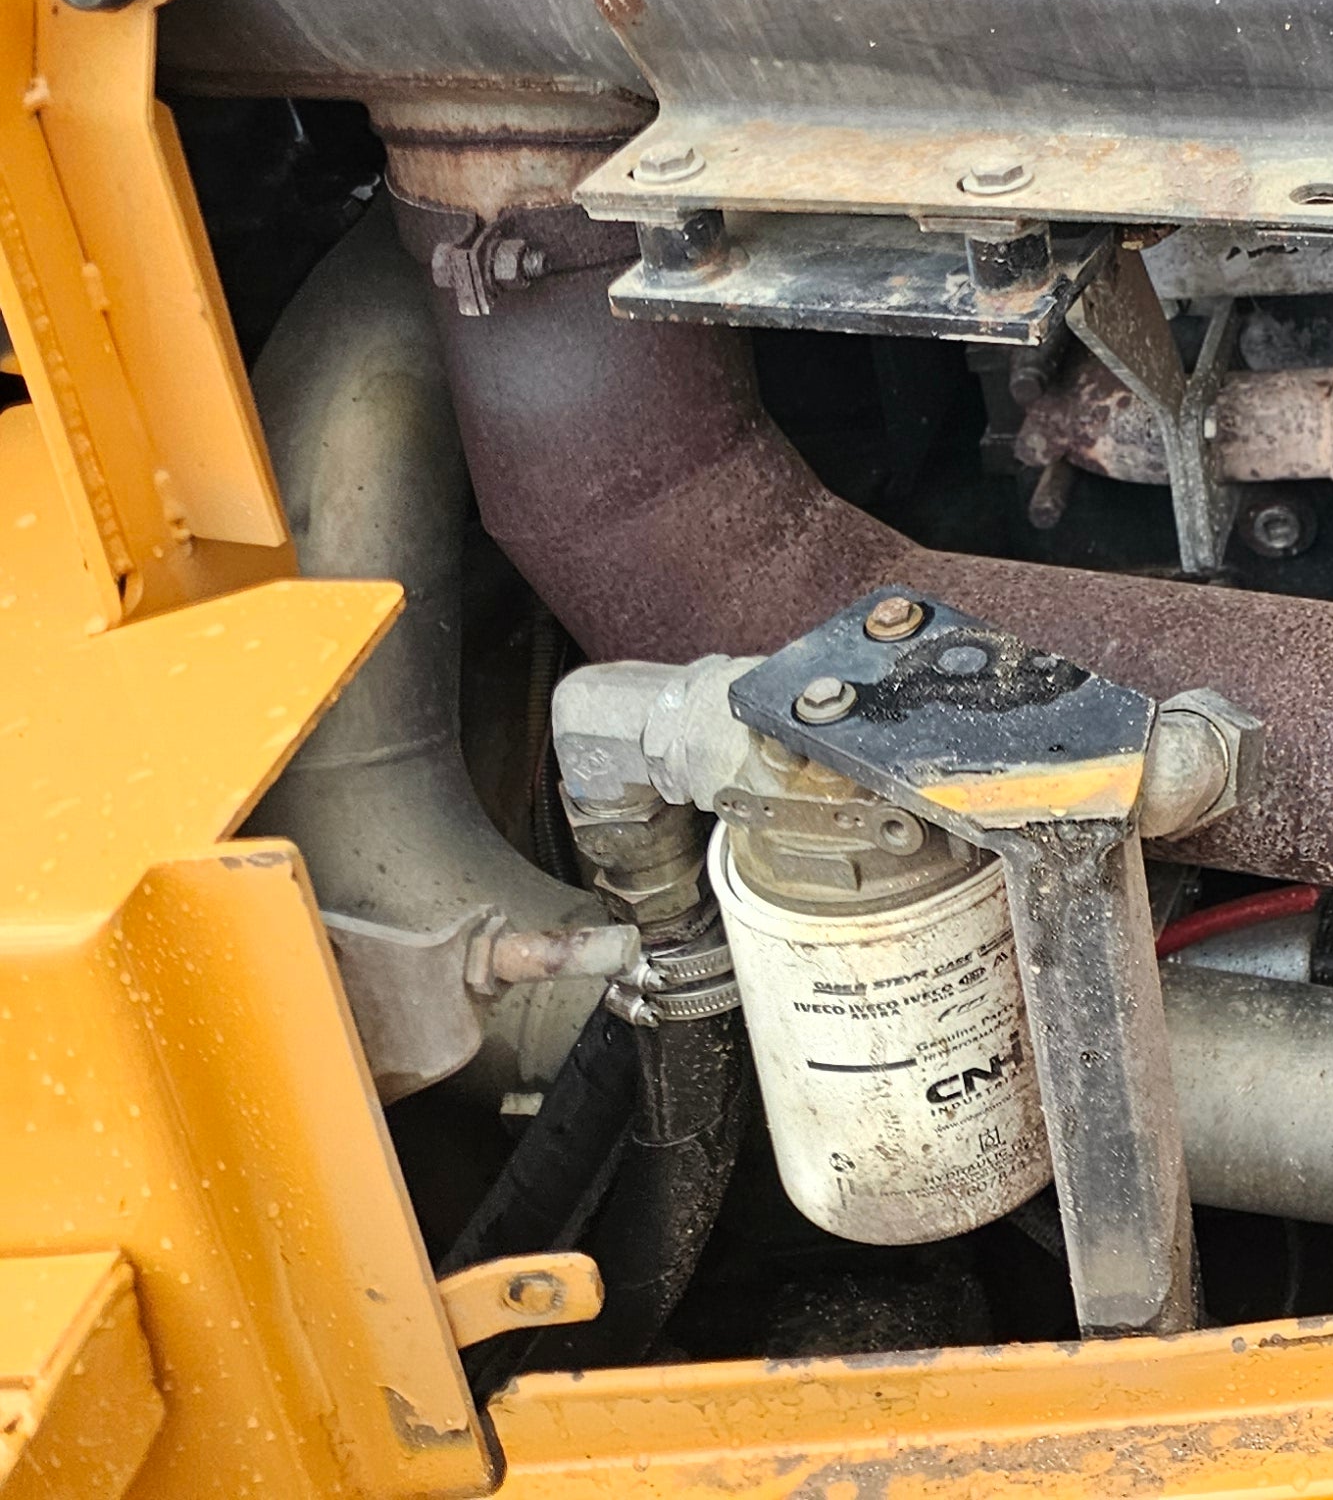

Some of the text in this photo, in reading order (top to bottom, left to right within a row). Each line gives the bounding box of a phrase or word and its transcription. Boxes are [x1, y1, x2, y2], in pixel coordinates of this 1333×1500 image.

[793, 983, 953, 1015] IVECO IVECO IVECO
[916, 1003, 1014, 1052] Genuine Parts
[926, 1040, 1024, 1104] CNH
